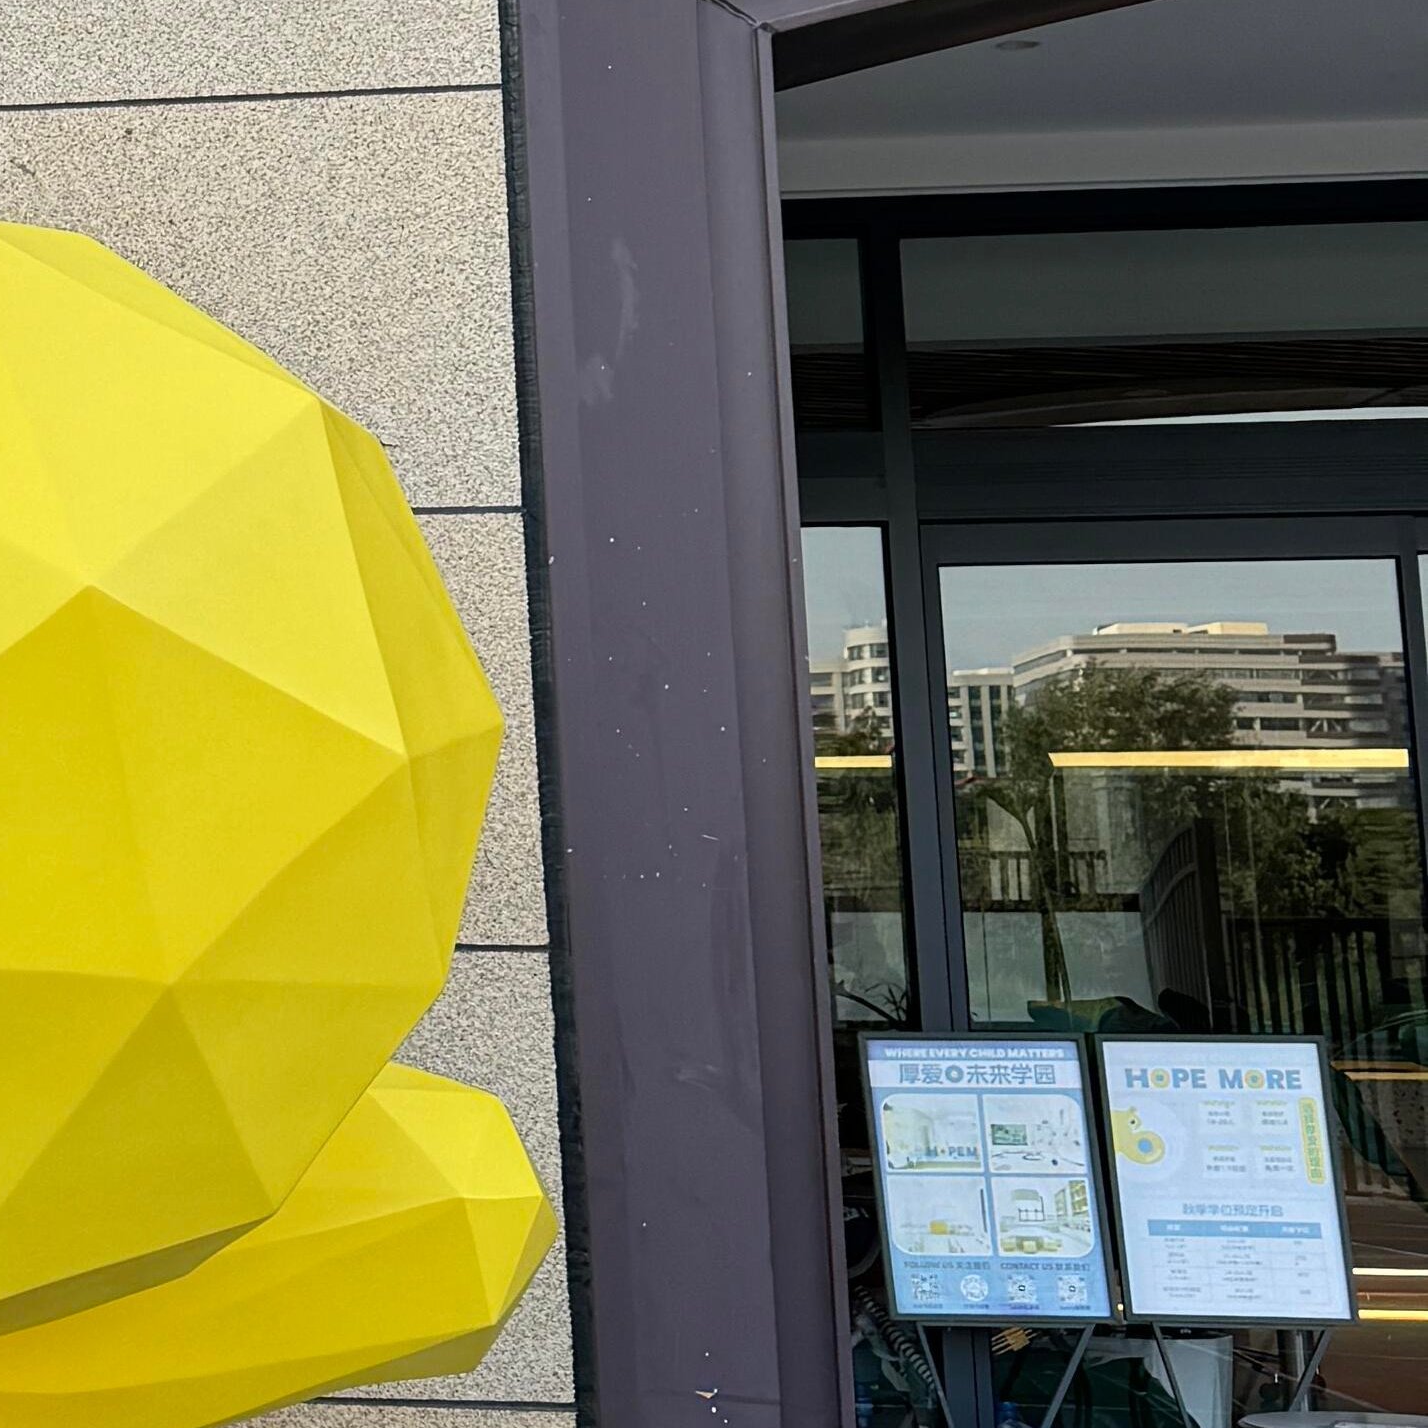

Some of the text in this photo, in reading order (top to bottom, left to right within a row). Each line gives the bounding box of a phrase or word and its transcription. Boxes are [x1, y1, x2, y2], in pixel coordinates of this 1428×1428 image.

[884, 1047, 1064, 1059] WHERE EVERY CHILD MATTERS
[1125, 1068, 1302, 1090] HOPE MORE
